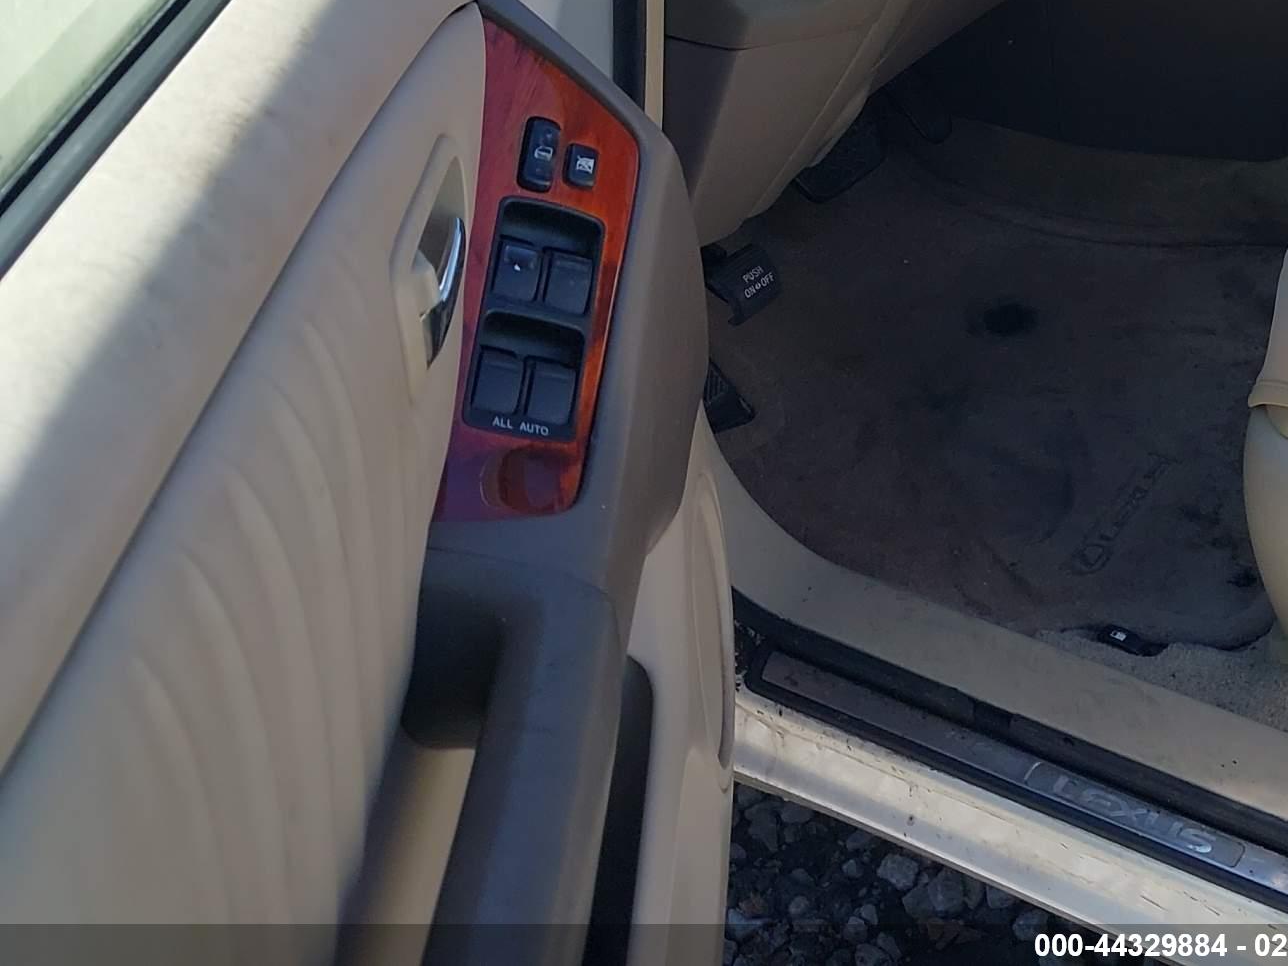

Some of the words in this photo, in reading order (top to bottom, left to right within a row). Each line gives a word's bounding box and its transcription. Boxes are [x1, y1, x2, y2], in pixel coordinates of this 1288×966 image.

[742, 265, 764, 283] PUSH
[744, 285, 757, 299] ON
[760, 271, 775, 287] OFF
[492, 416, 513, 430] ALL
[519, 421, 549, 436] AUTO
[1053, 775, 1216, 853] LEXUS
